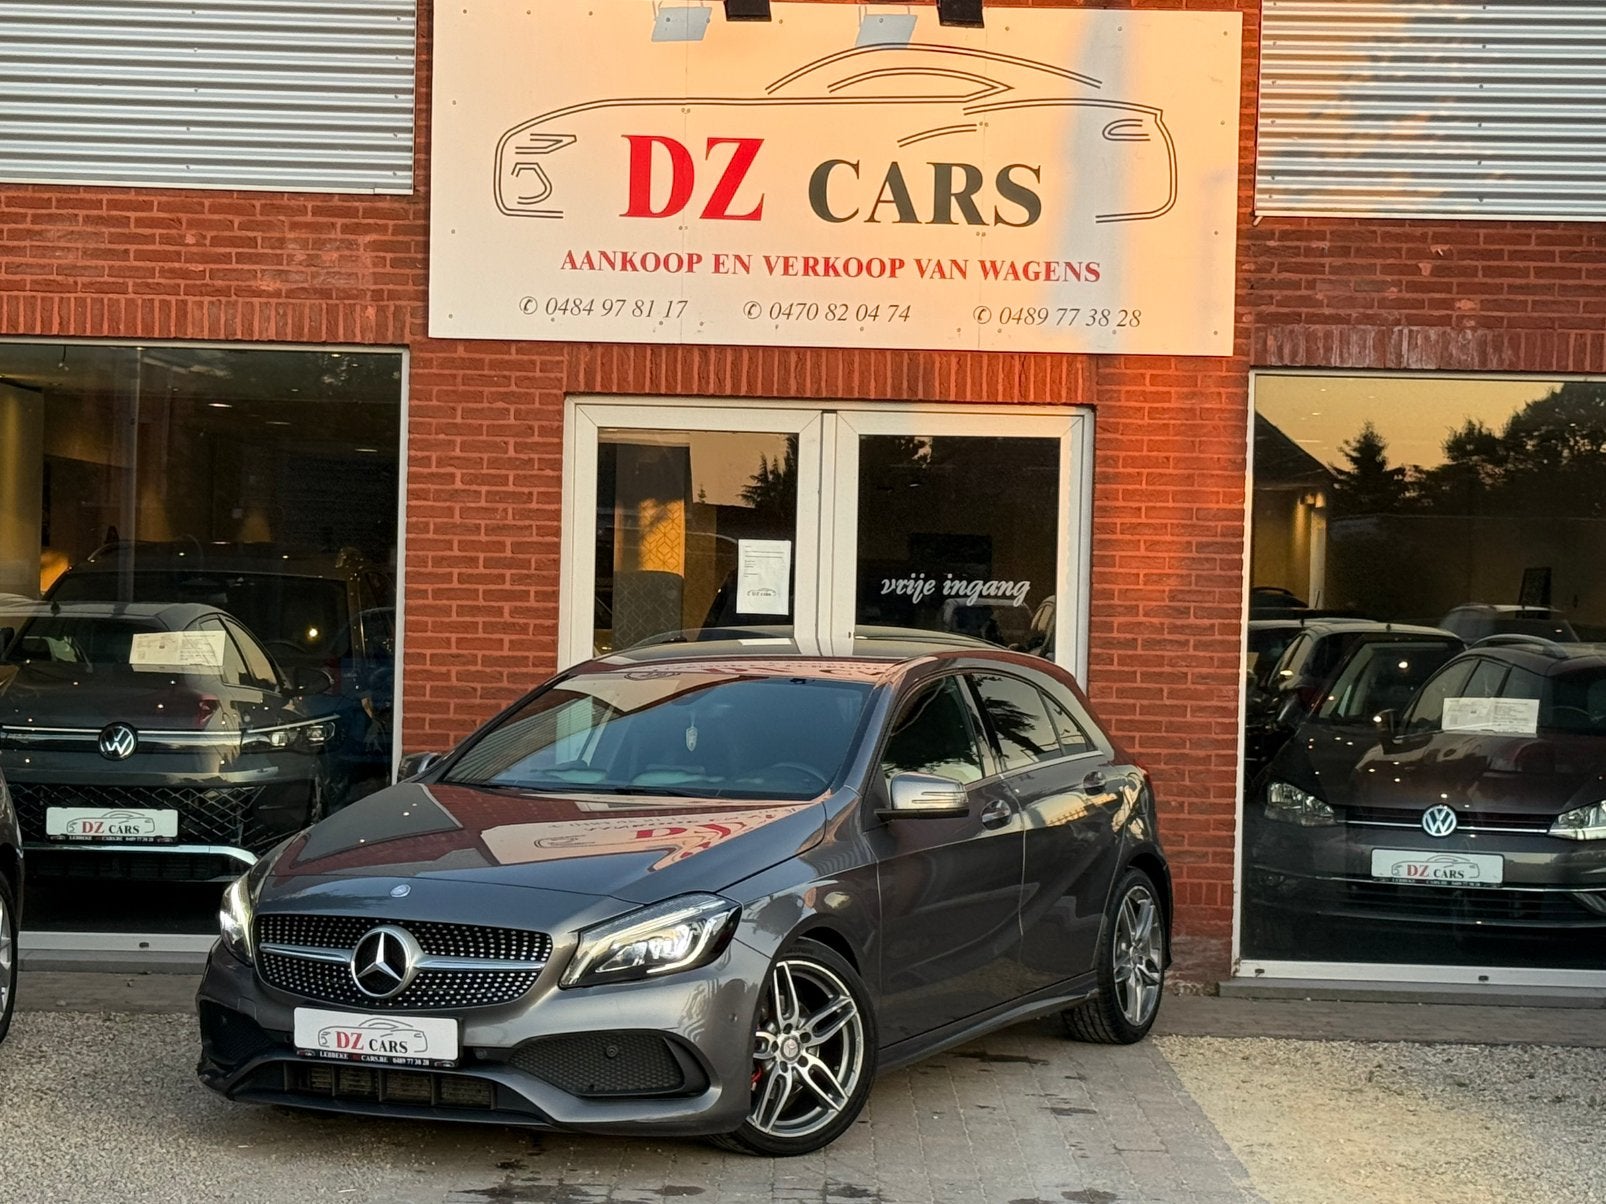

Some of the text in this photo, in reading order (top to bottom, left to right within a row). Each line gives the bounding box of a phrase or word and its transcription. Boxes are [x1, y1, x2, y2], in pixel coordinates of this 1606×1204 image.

[618, 134, 1042, 228] DZ CARS
[560, 249, 1101, 283] AANKOOP EN VERKOOP VAN WAGENS
[545, 297, 689, 319] 0484 97 81 17
[769, 301, 911, 323] 0470 82 04 74
[999, 306, 1142, 328] 0489 77 38 28
[880, 572, 1031, 607] vrije ingang
[82, 821, 140, 835] DZ CARS
[1407, 864, 1465, 879] DZ CARS
[335, 1030, 408, 1054] DZ CARS
